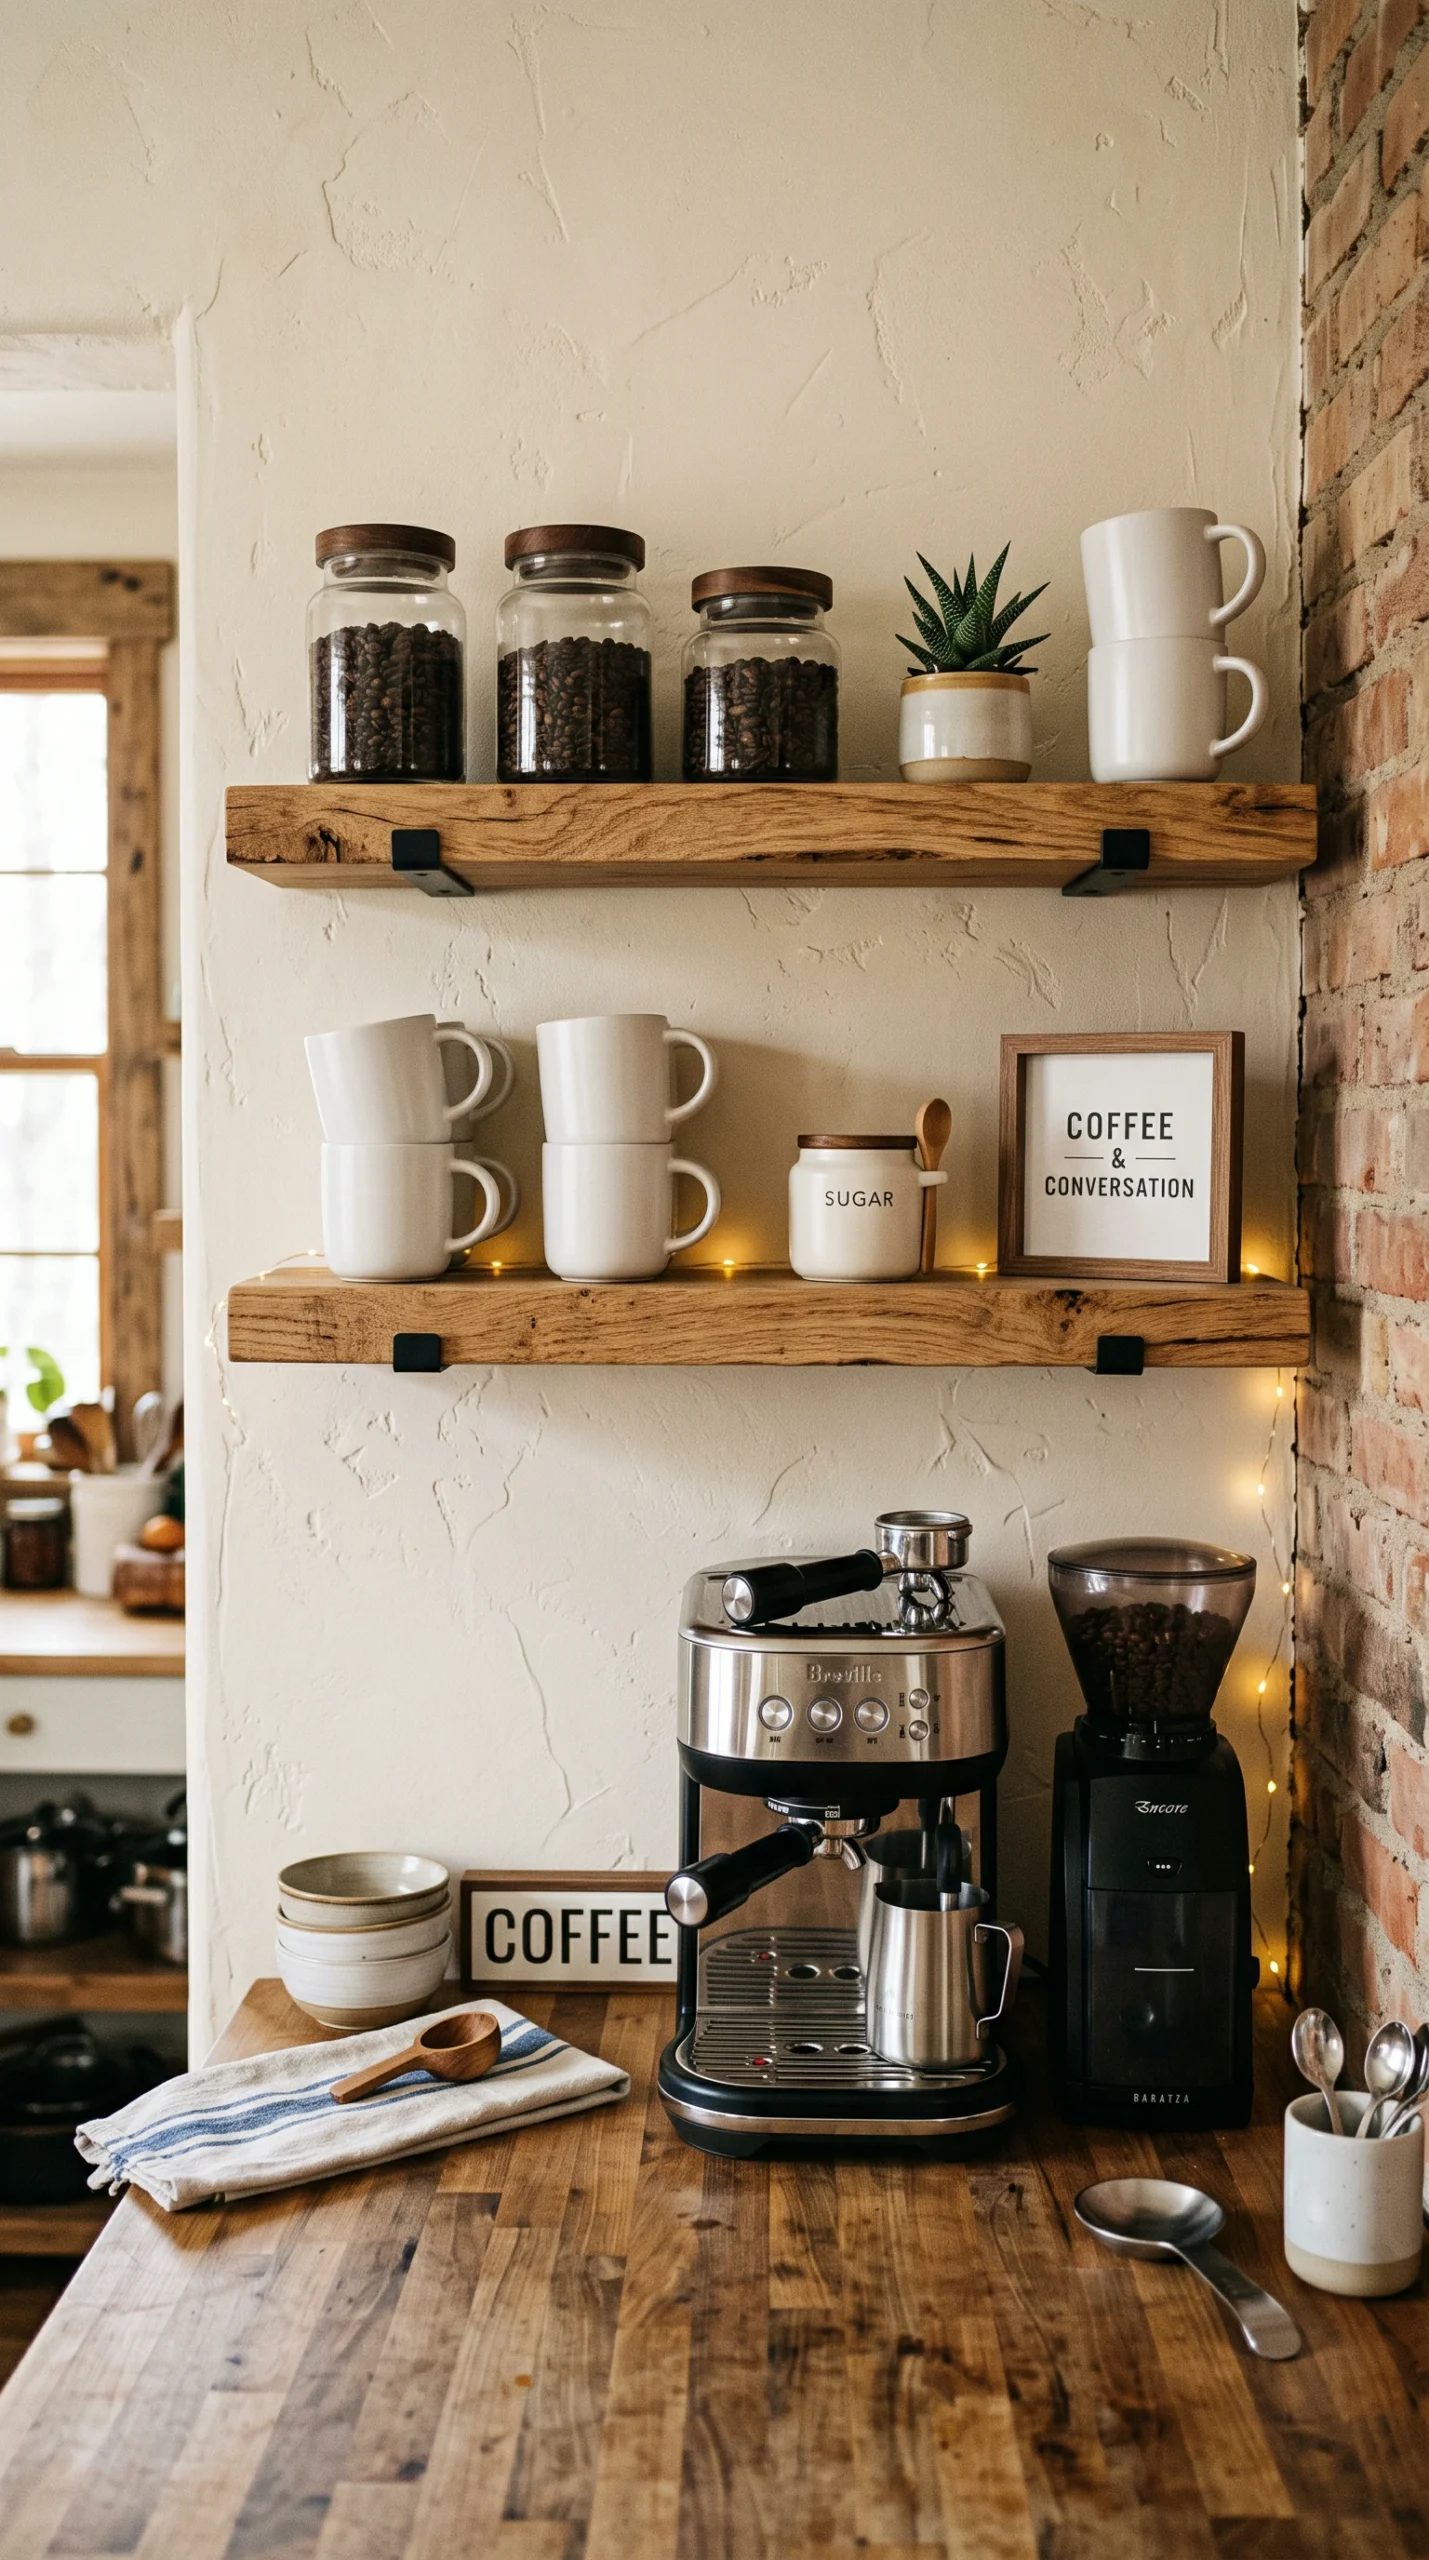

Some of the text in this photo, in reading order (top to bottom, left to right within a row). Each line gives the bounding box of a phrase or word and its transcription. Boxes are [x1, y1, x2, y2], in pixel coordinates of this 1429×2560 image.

[1066, 1111, 1174, 1141] COFFEE
[1111, 1147, 1127, 1170] &
[1045, 1175, 1195, 1199] CONVERSATION
[824, 1189, 895, 1208] SUGAR
[807, 1663, 883, 1683] Breville
[1134, 1800, 1189, 1814] Encore
[485, 1908, 673, 1965] COFFEE
[1133, 2092, 1190, 2104] BARATZA
